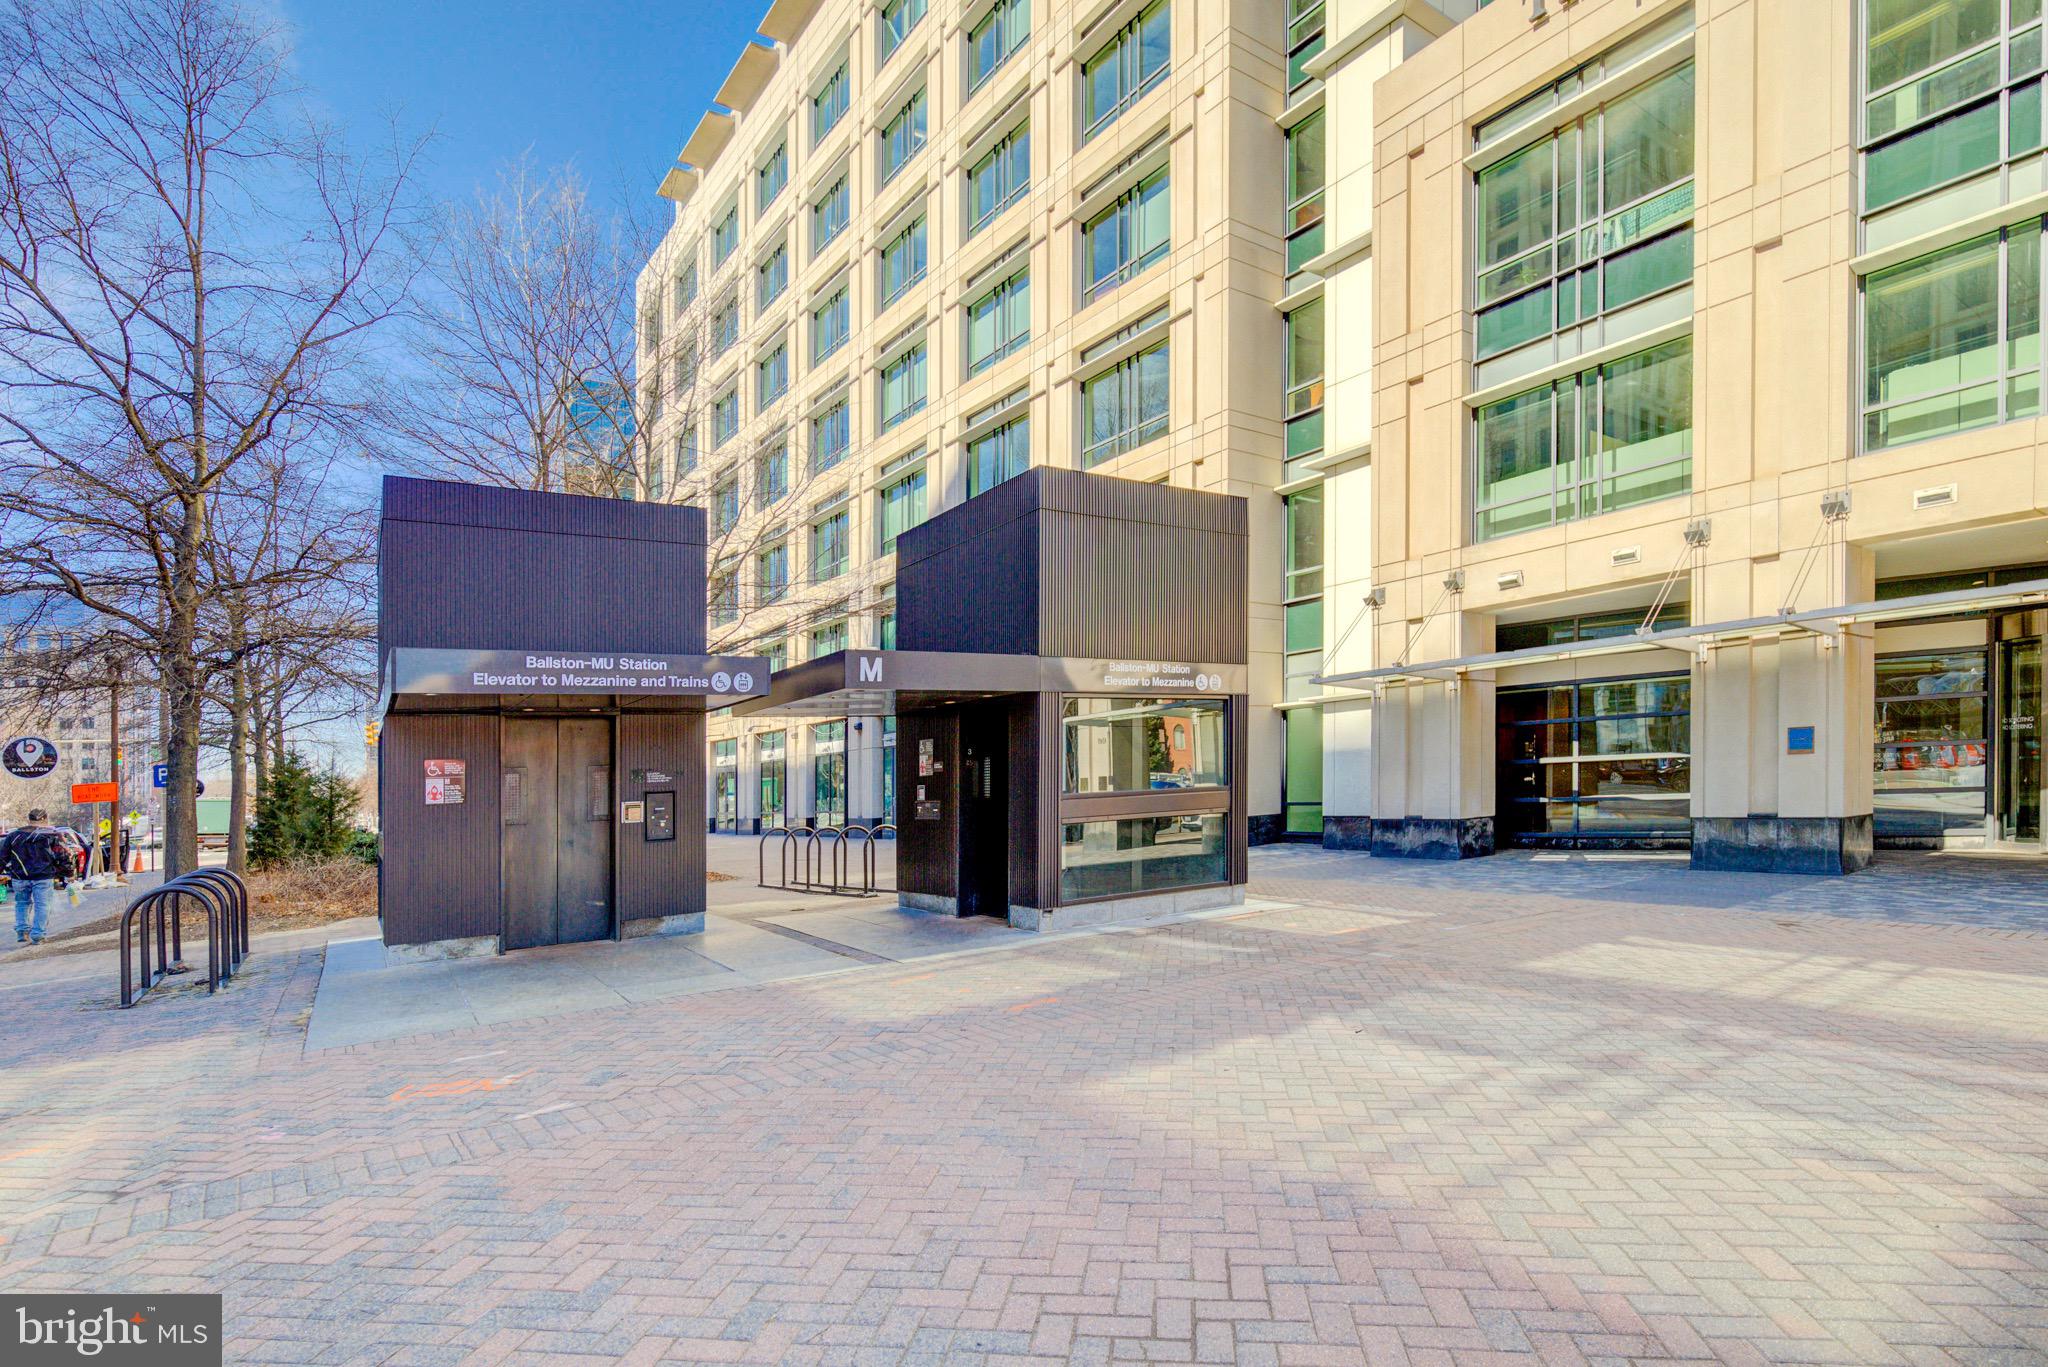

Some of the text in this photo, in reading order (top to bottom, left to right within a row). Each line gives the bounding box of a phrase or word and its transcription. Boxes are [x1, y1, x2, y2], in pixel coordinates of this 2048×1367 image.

[525, 655, 668, 671] Ballston-MU Station
[860, 656, 882, 682] M
[1109, 662, 1191, 674] Ballston-MU Station
[473, 672, 709, 688] Elevator to Mezzanine and Trains
[1104, 675, 1195, 688] Elevator to Mezzanine
[158, 767, 168, 782] P
